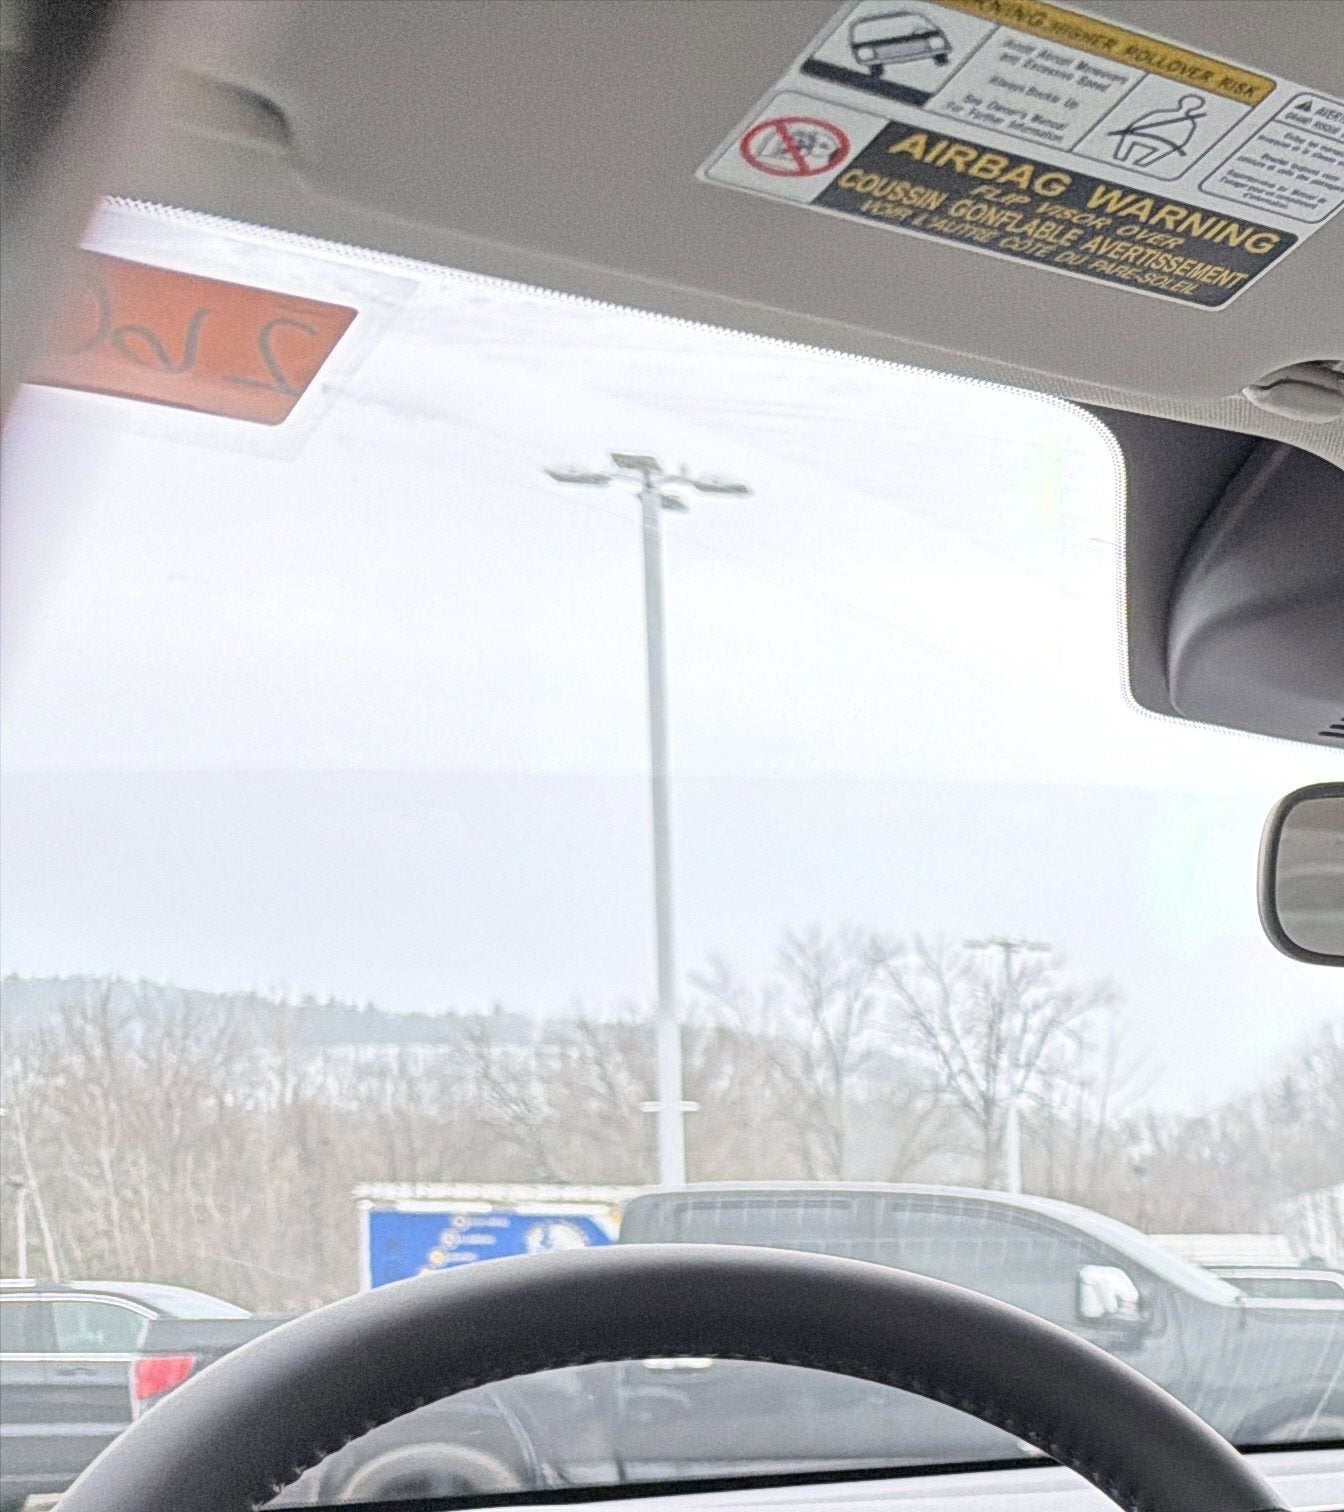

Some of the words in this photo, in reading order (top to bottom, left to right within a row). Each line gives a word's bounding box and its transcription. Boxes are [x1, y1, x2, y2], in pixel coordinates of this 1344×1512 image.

[1125, 44, 1216, 83] ROLLOVER
[1218, 77, 1259, 98] RISK
[838, 168, 949, 211] COUSSIN
[949, 198, 1084, 248] GONFLABLE
[1080, 235, 1250, 289] AVERTISSEMENT
[889, 132, 1073, 198] AIRBAG
[1086, 184, 1281, 255] WARNING
[970, 185, 1032, 205] FLIP
[1036, 202, 1112, 230] VISOR
[1116, 224, 1186, 249] OVER
[860, 199, 913, 222] VOIR
[912, 212, 1001, 243] L'AUTRE
[1055, 250, 1086, 266] DU
[1089, 260, 1201, 296] PARE-SOLEIL
